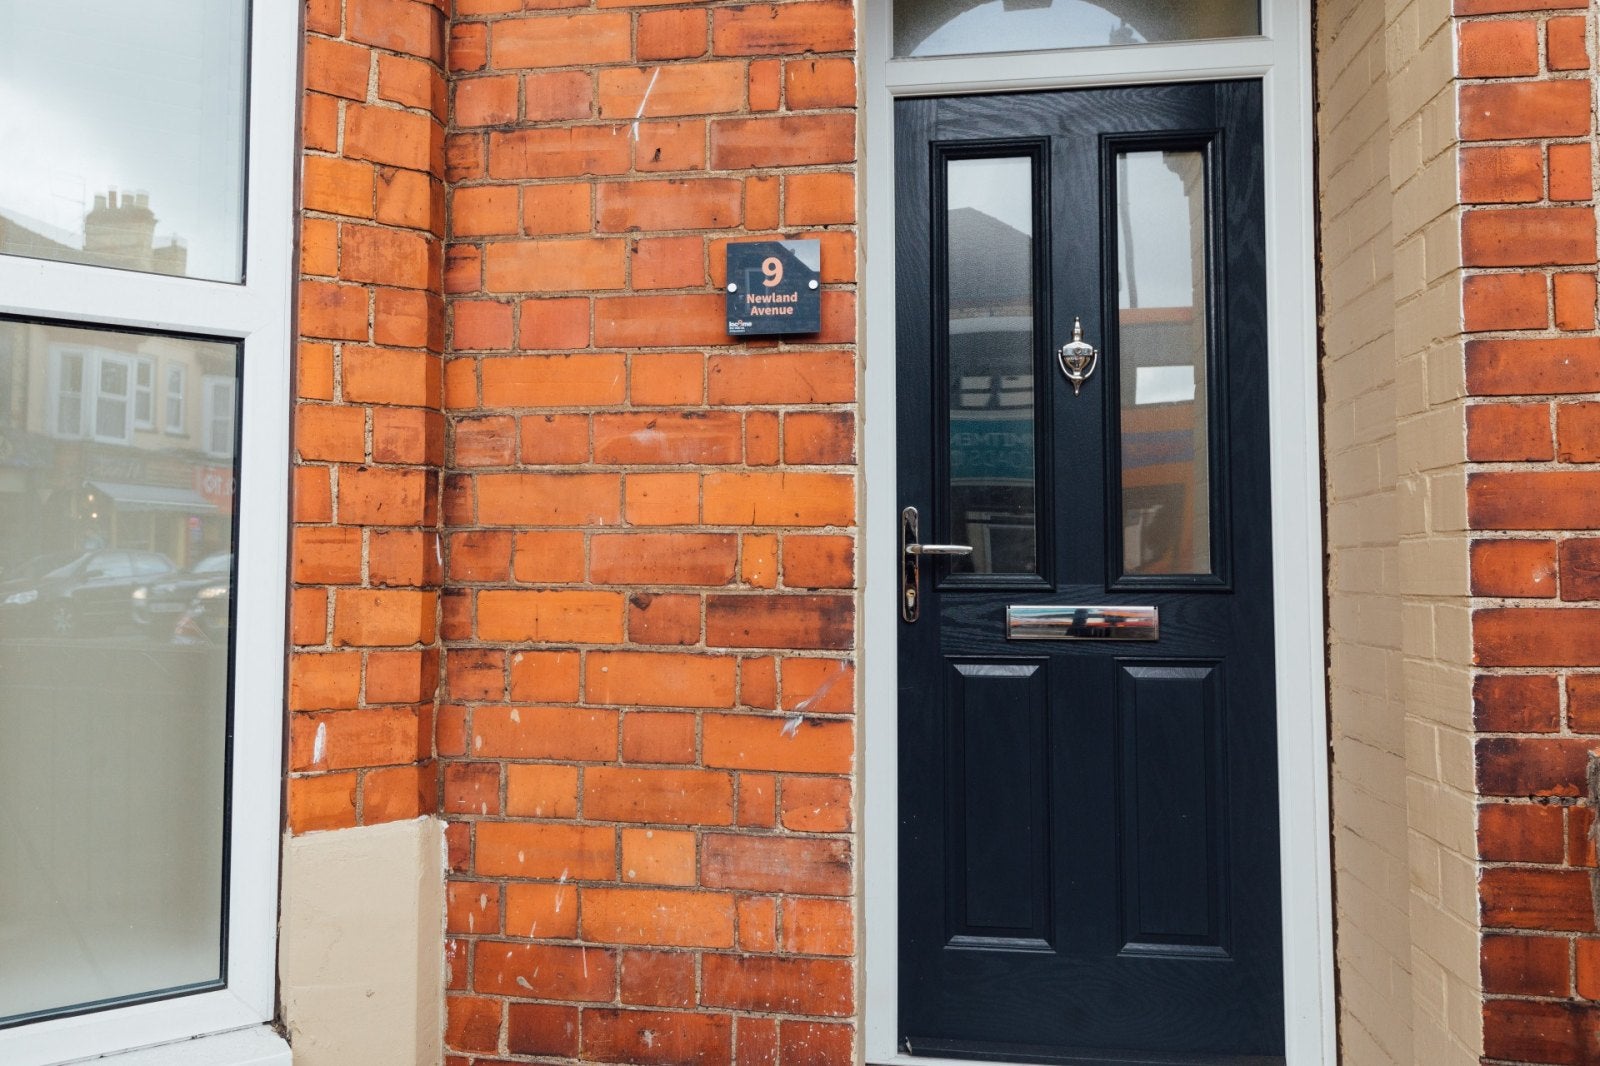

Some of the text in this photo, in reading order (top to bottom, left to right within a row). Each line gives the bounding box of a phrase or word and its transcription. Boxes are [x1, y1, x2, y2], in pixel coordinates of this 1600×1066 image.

[761, 256, 784, 288] 9
[746, 291, 798, 304] Newland
[750, 306, 794, 316] Avenue
